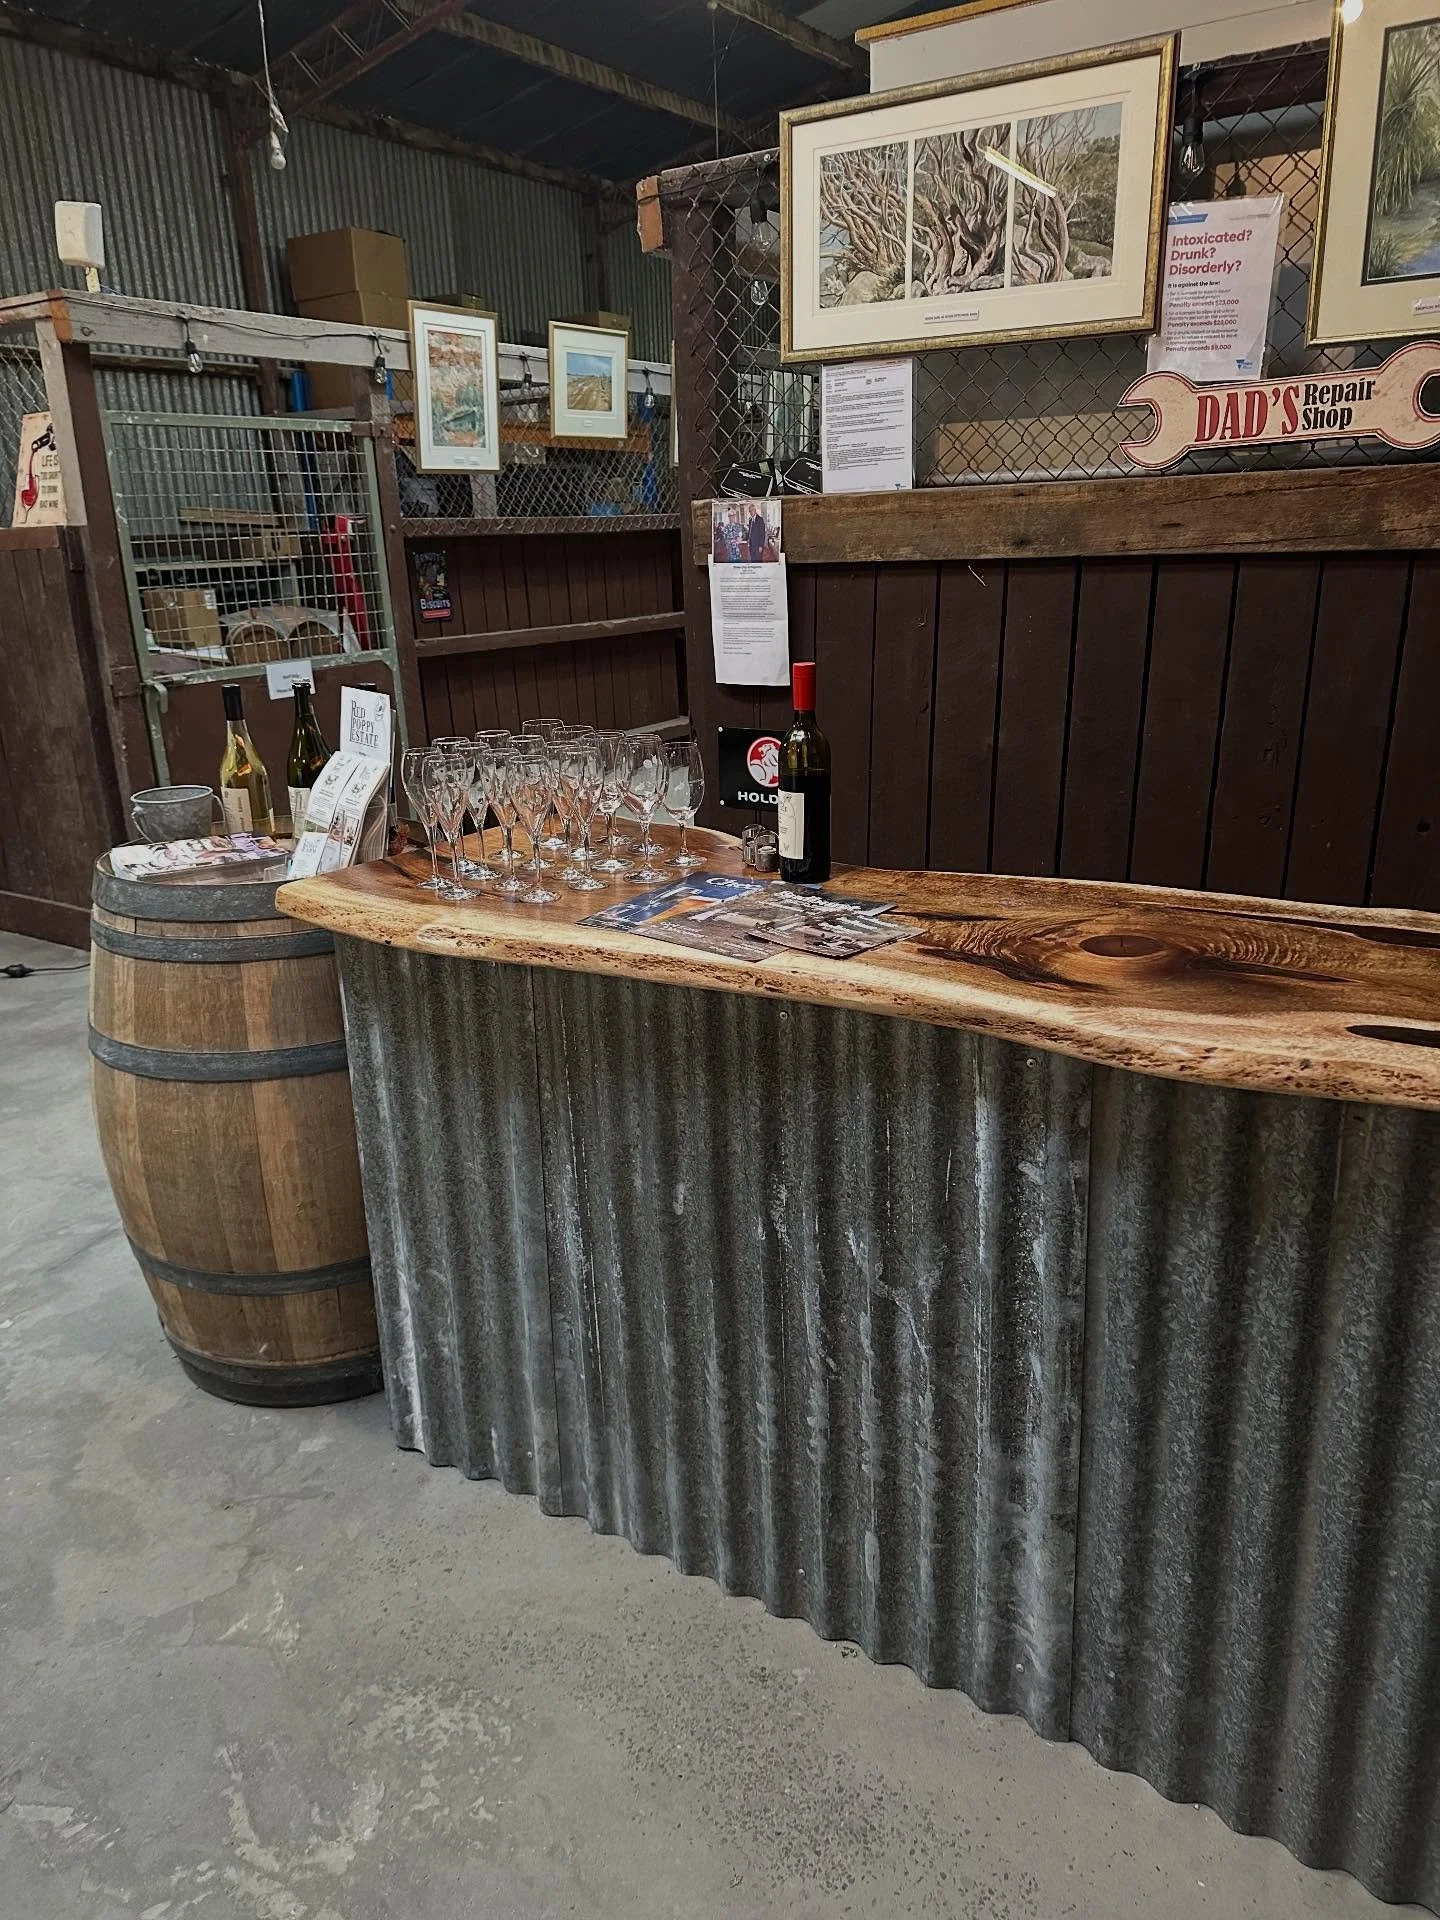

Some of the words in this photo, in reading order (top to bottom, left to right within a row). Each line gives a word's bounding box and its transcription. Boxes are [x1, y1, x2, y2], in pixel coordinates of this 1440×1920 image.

[1172, 230, 1253, 247] Intoxicated?
[1170, 247, 1216, 261] Drunk?
[1169, 260, 1242, 277] Disorderly?
[1215, 298, 1239, 306] $23,000
[1302, 377, 1376, 406] Repair
[1195, 384, 1301, 442] DAD'S
[1301, 406, 1353, 431] Shop
[351, 700, 366, 718] RED
[352, 717, 375, 734] POPPY
[351, 730, 379, 747] ESTATE
[738, 790, 779, 805] HOLD
